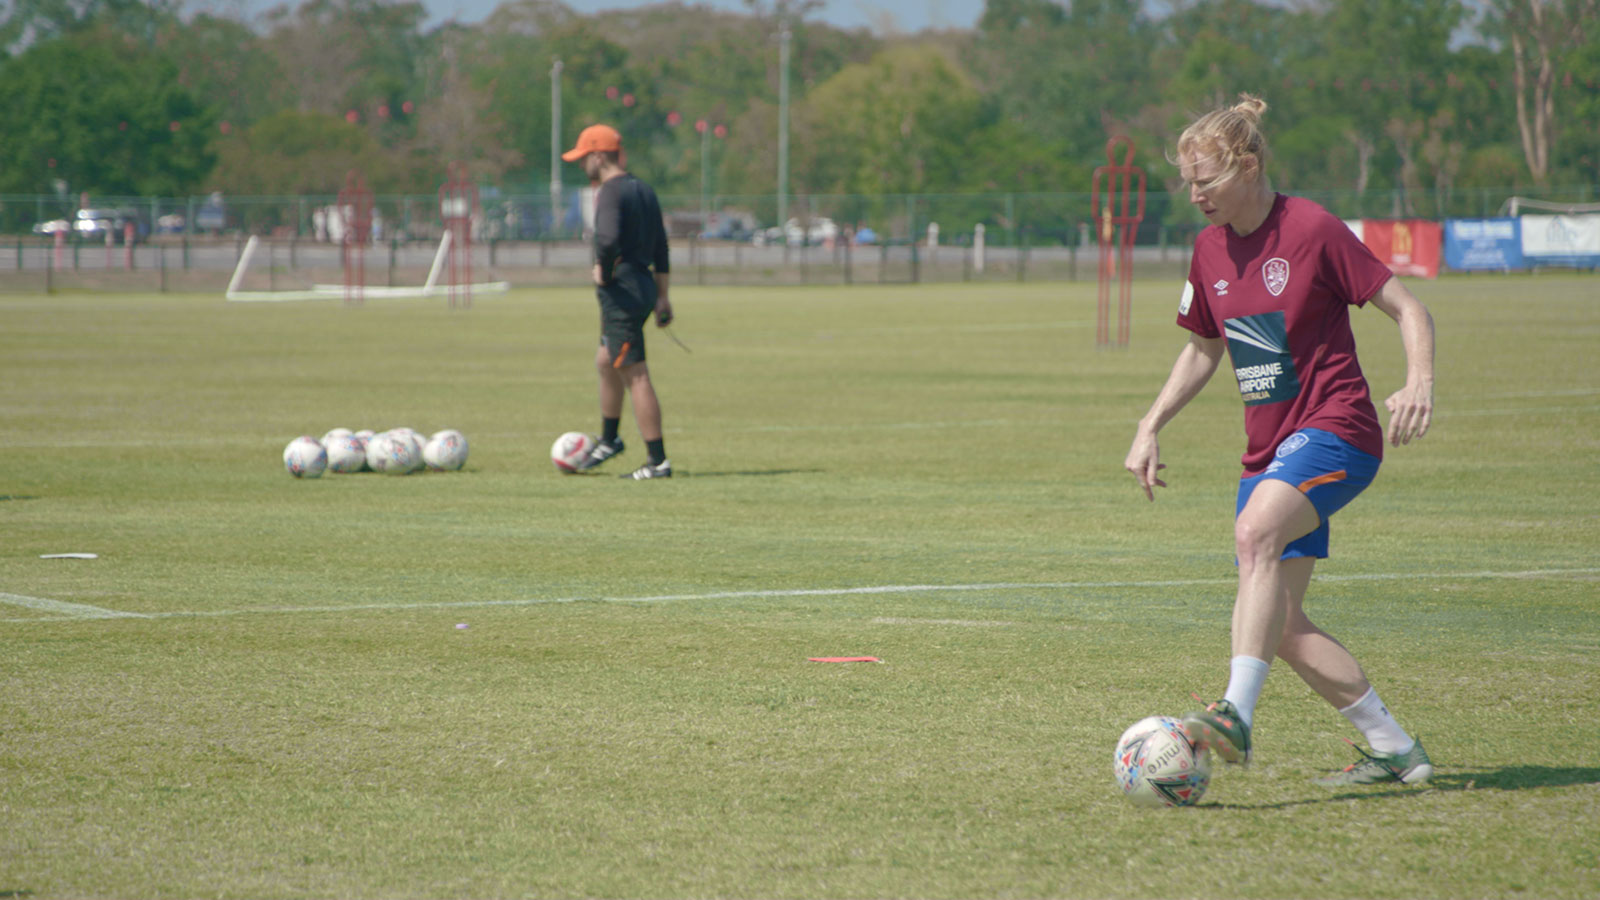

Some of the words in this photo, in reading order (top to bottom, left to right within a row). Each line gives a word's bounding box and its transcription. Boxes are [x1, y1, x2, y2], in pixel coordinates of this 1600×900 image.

[1236, 362, 1283, 380] BRISBANE
[1240, 376, 1275, 392] AIRPORT
[1147, 743, 1180, 774] mitre
